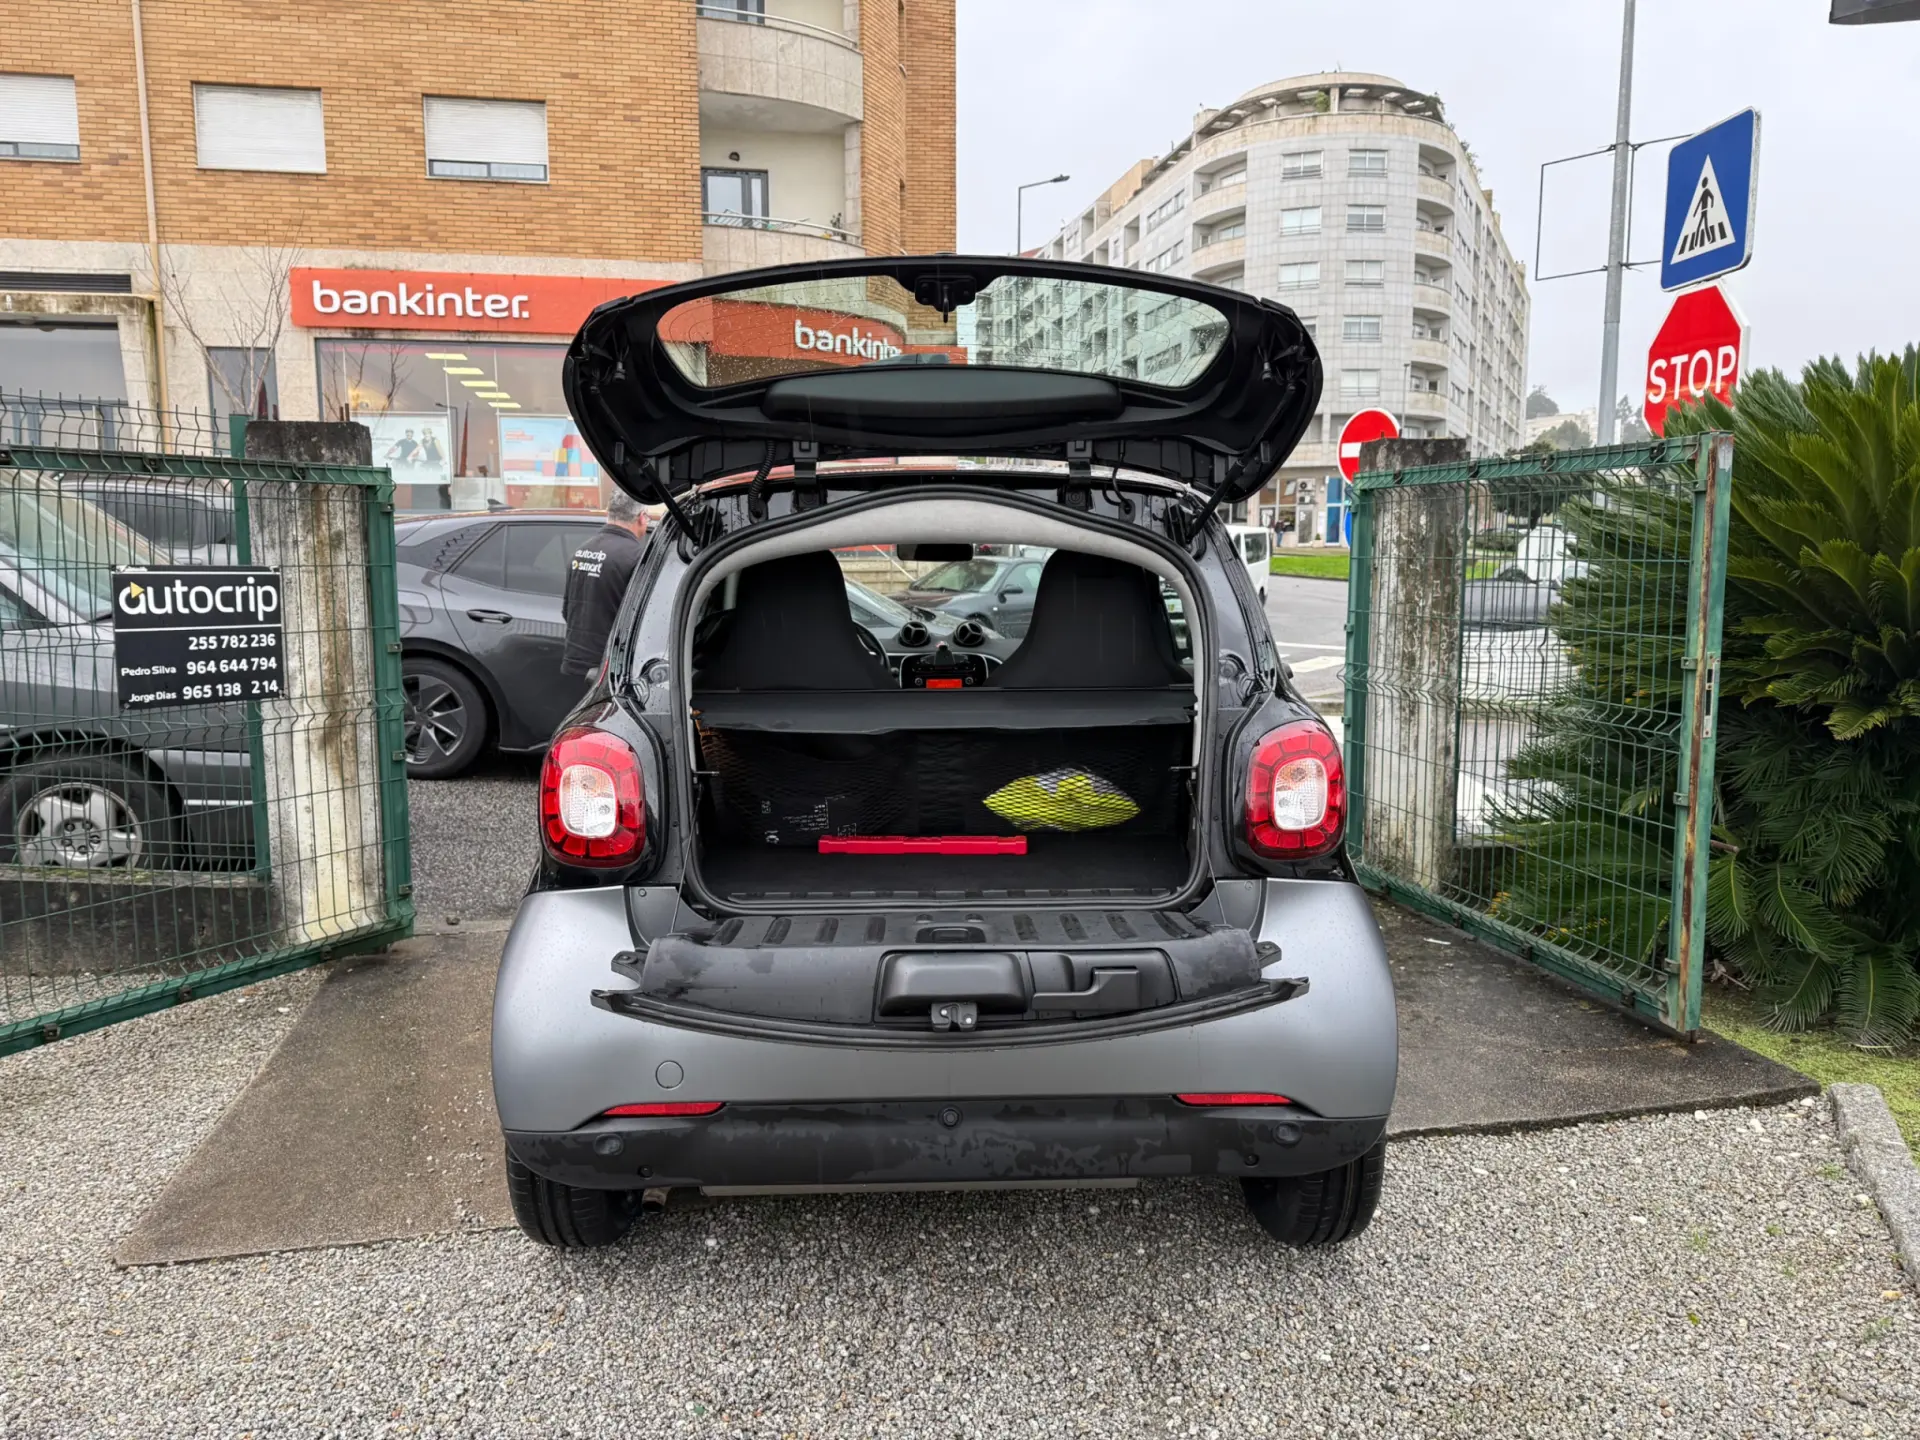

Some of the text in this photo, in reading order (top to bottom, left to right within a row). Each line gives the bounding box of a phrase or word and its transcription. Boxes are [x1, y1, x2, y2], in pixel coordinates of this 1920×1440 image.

[312, 279, 530, 319] bankinter.
[794, 319, 902, 361] bankinte
[1647, 345, 1737, 404] STOP
[578, 562, 602, 573] smart
[118, 576, 279, 621] autocrip
[188, 633, 276, 650] 255 782 236
[121, 656, 277, 676] Pedro Silva 964 644 794
[128, 692, 155, 703] Jorge
[155, 690, 177, 700] Dias
[182, 685, 212, 700] 965
[215, 682, 242, 696] 138
